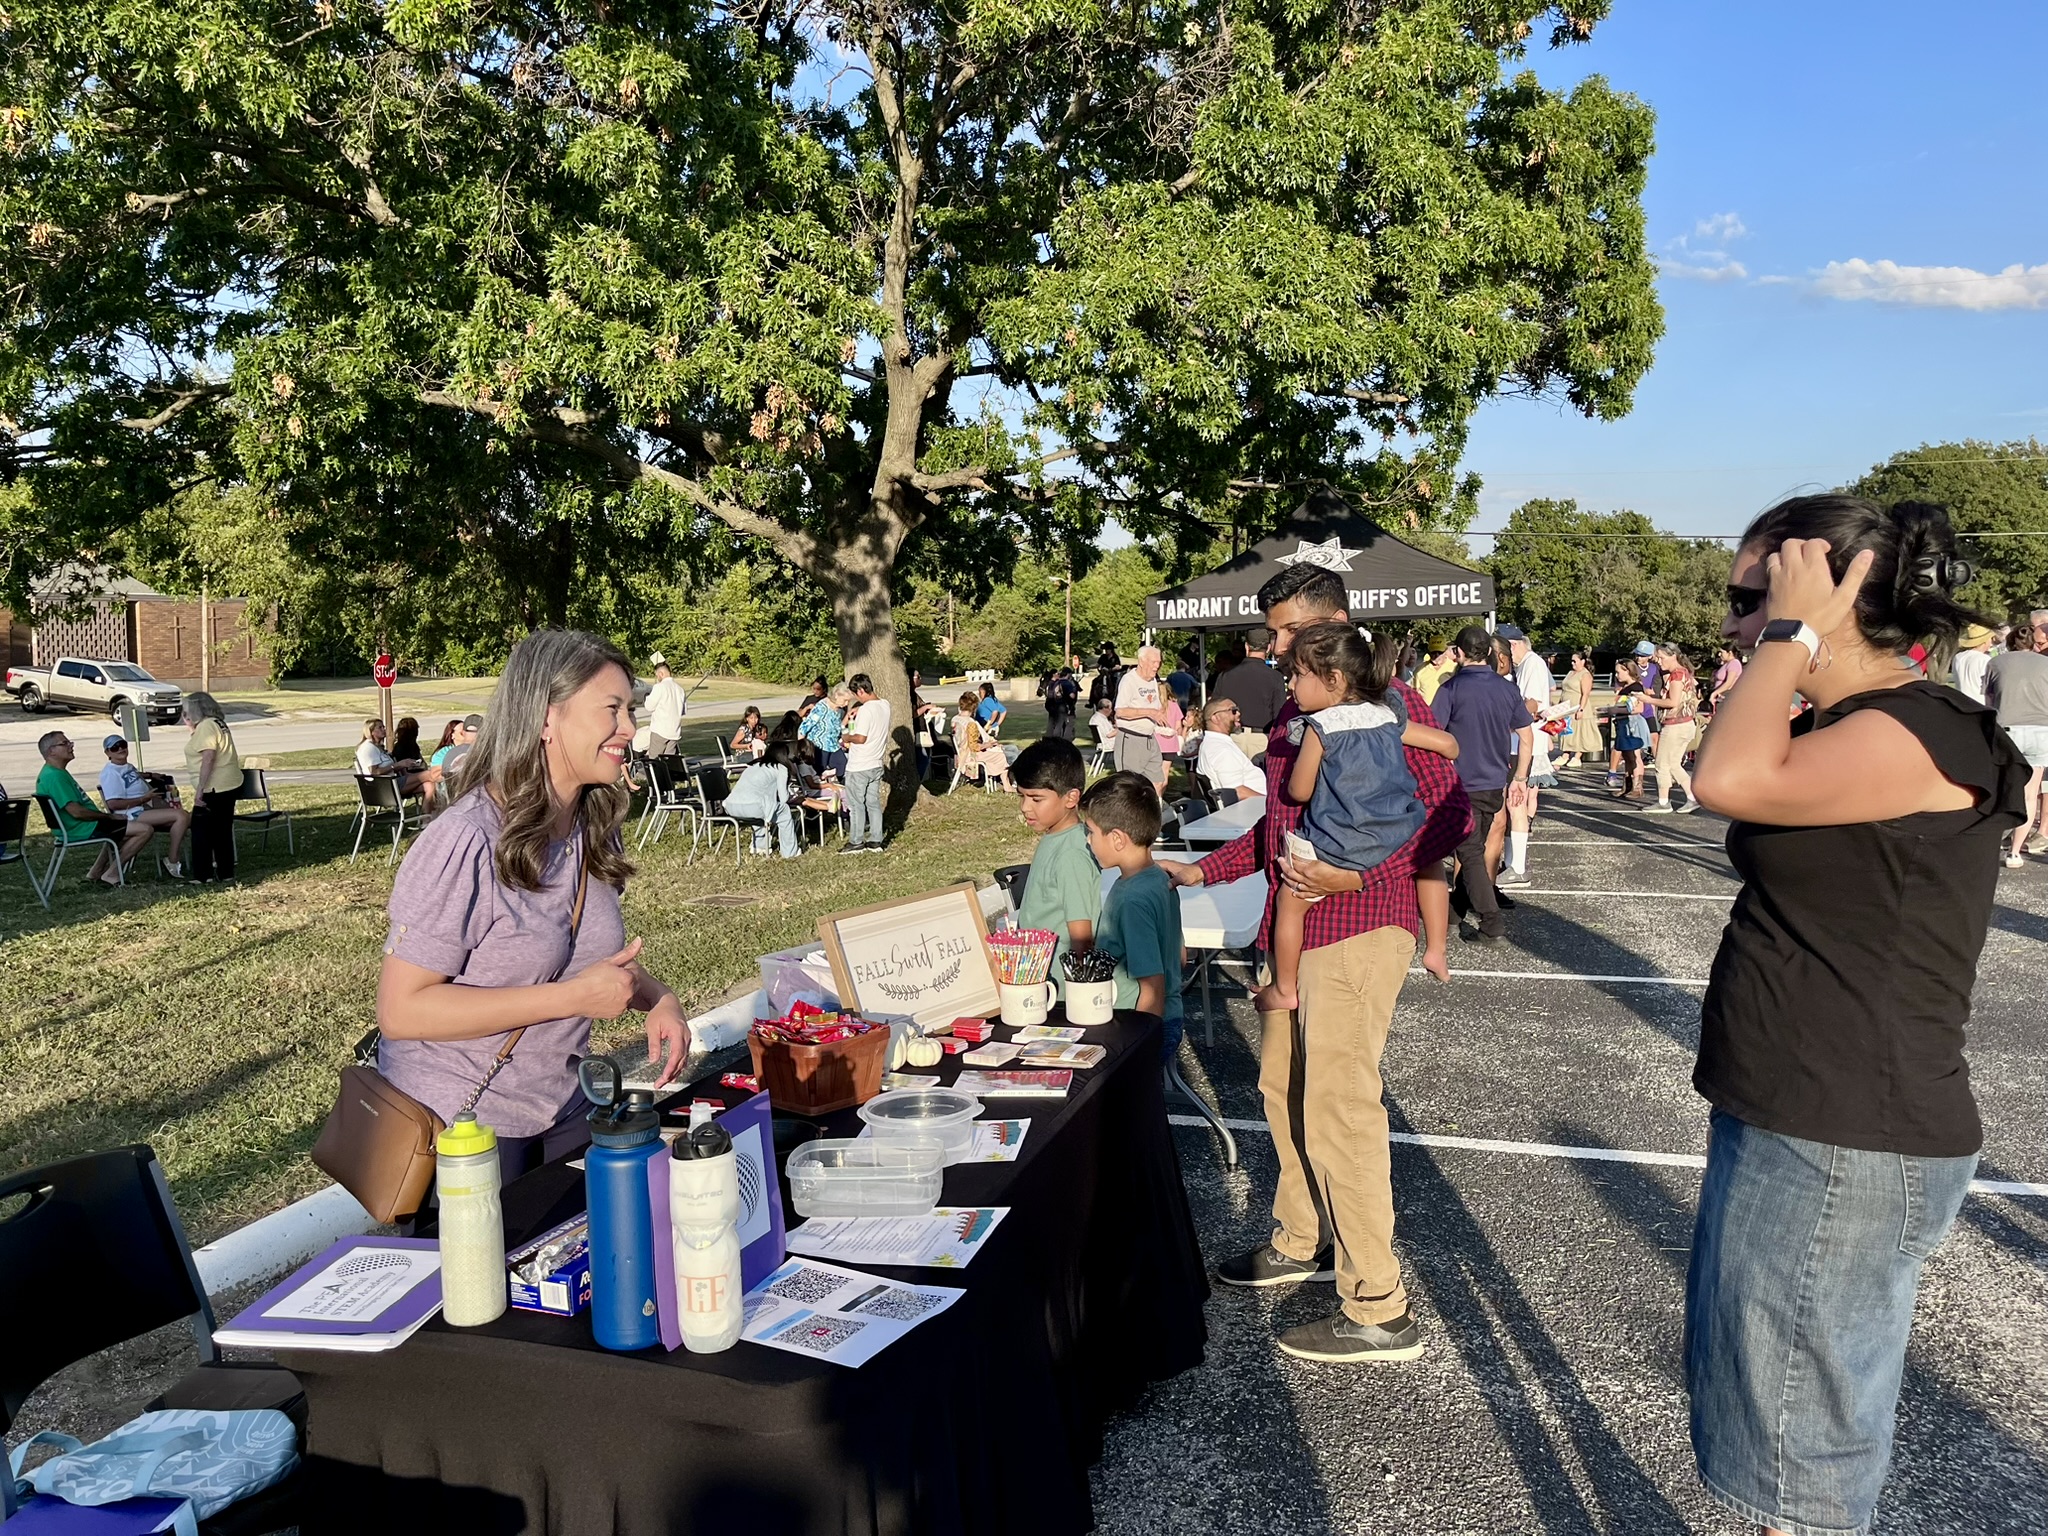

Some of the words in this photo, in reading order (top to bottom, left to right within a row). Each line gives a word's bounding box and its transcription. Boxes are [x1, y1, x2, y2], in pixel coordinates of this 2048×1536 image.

[1156, 595, 1233, 620] TARRANT
[1344, 587, 1409, 610] RIFF'S
[1414, 581, 1482, 607] OFFICE
[853, 958, 894, 984] FALL
[891, 933, 940, 978] Sweet
[936, 936, 972, 961] FALL
[298, 1300, 322, 1314] The
[312, 1276, 370, 1315] International
[330, 1296, 361, 1316] STEM
[357, 1271, 397, 1297] Academy
